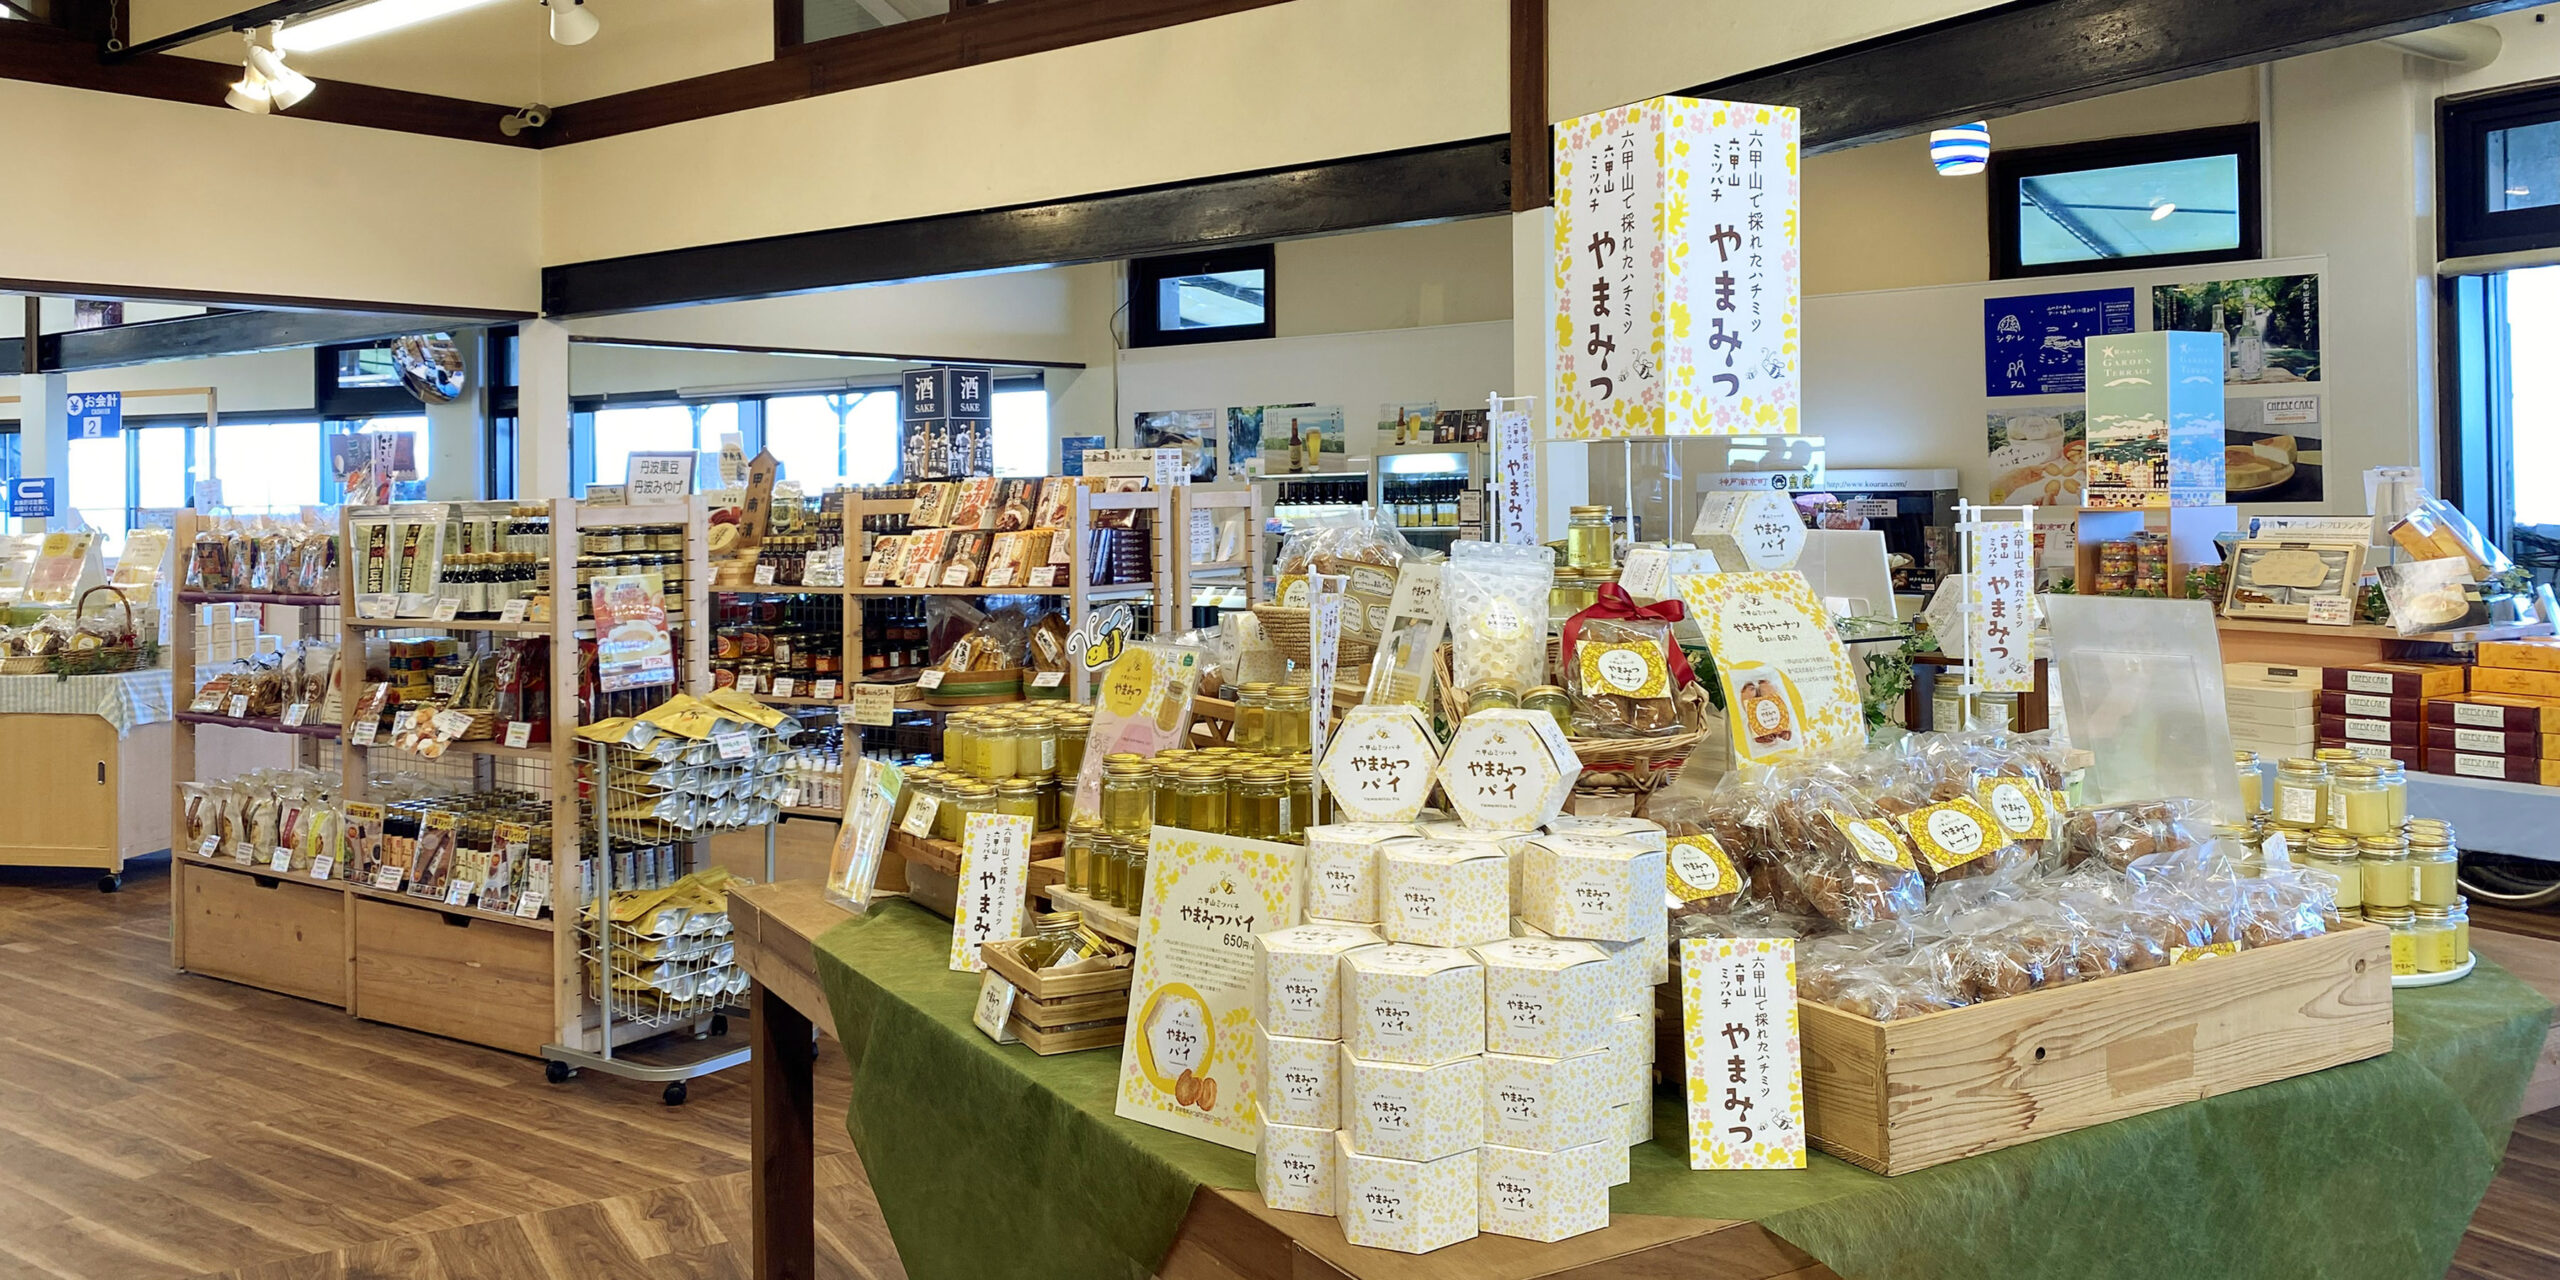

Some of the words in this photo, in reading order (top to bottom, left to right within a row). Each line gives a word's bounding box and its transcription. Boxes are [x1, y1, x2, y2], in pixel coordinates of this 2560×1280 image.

[1604, 145, 1615, 194] 六甲山
[1728, 138, 1741, 188] 六甲山
[1711, 143, 1723, 203] ミツバチ
[1589, 155, 1601, 213] ミツバチ
[1621, 130, 1635, 335] 六甲山で採れたハチミツ
[1748, 129, 1764, 333] 六甲山で採れたハチミツ
[1588, 231, 1617, 401] やまみつ
[1708, 223, 1743, 397] やまみつ
[915, 375, 935, 401] 酒
[960, 375, 979, 400] 酒
[84, 394, 118, 408] お会計
[915, 403, 935, 413] SAKE
[960, 402, 980, 412] SAKE
[2267, 401, 2292, 411] CHEESE
[2294, 400, 2314, 410] CAKE
[88, 420, 96, 435] 2
[640, 460, 679, 475] 丹波黒豆
[634, 480, 683, 495] 丹波みやげ
[1754, 522, 1790, 537] やまみつ
[2034, 523, 2067, 531] 南京町
[1987, 576, 2010, 661] やまみつ
[2351, 675, 2371, 683] CHEESE
[2372, 675, 2388, 684] CAKE
[1114, 682, 1142, 698] やまみつ
[2349, 698, 2369, 706] CHEESE
[2370, 699, 2386, 708] CAKE
[2458, 707, 2481, 716] CHEESE
[2483, 709, 2499, 718] CAKE
[2349, 722, 2369, 730] CHEESE
[2370, 723, 2386, 732] CAKE
[2459, 733, 2481, 741] CHEESE
[2483, 735, 2500, 743] CAKE
[1351, 756, 1410, 775] やまみつ
[2459, 758, 2481, 766] CHEESE
[2483, 759, 2500, 768] CAKE
[1468, 761, 1526, 781] やまみつ
[1361, 776, 1400, 793] パイ
[1478, 783, 1517, 800] パイ
[1941, 823, 1971, 838] やまみつ
[1326, 870, 1356, 882] やまみつ
[1404, 893, 1435, 905] やまみつ
[1576, 888, 1610, 900] やまみつ
[974, 871, 996, 948] やまみ
[1180, 905, 1254, 932] やまみつパイ
[1735, 963, 1747, 997] 六甲山
[1285, 984, 1318, 997] やまみつ
[1720, 968, 1732, 1009] ミツバチ
[1375, 1007, 1410, 1020] やまみつ
[1507, 1000, 1542, 1013] やまみつ
[1752, 956, 1770, 1098] 六甲山で採れたハチミツ
[1166, 1028, 1196, 1045] やまみつ
[1169, 1047, 1191, 1059] パイ
[1285, 1073, 1318, 1086] やまみつ
[1721, 1022, 1754, 1143] やまみつ
[1500, 1092, 1535, 1105] やまみつ
[1373, 1101, 1407, 1115] やまみつ
[1283, 1160, 1315, 1172] やまみつ
[1496, 1182, 1531, 1195] やまみつ
[1366, 1193, 1400, 1207] やまみつ
